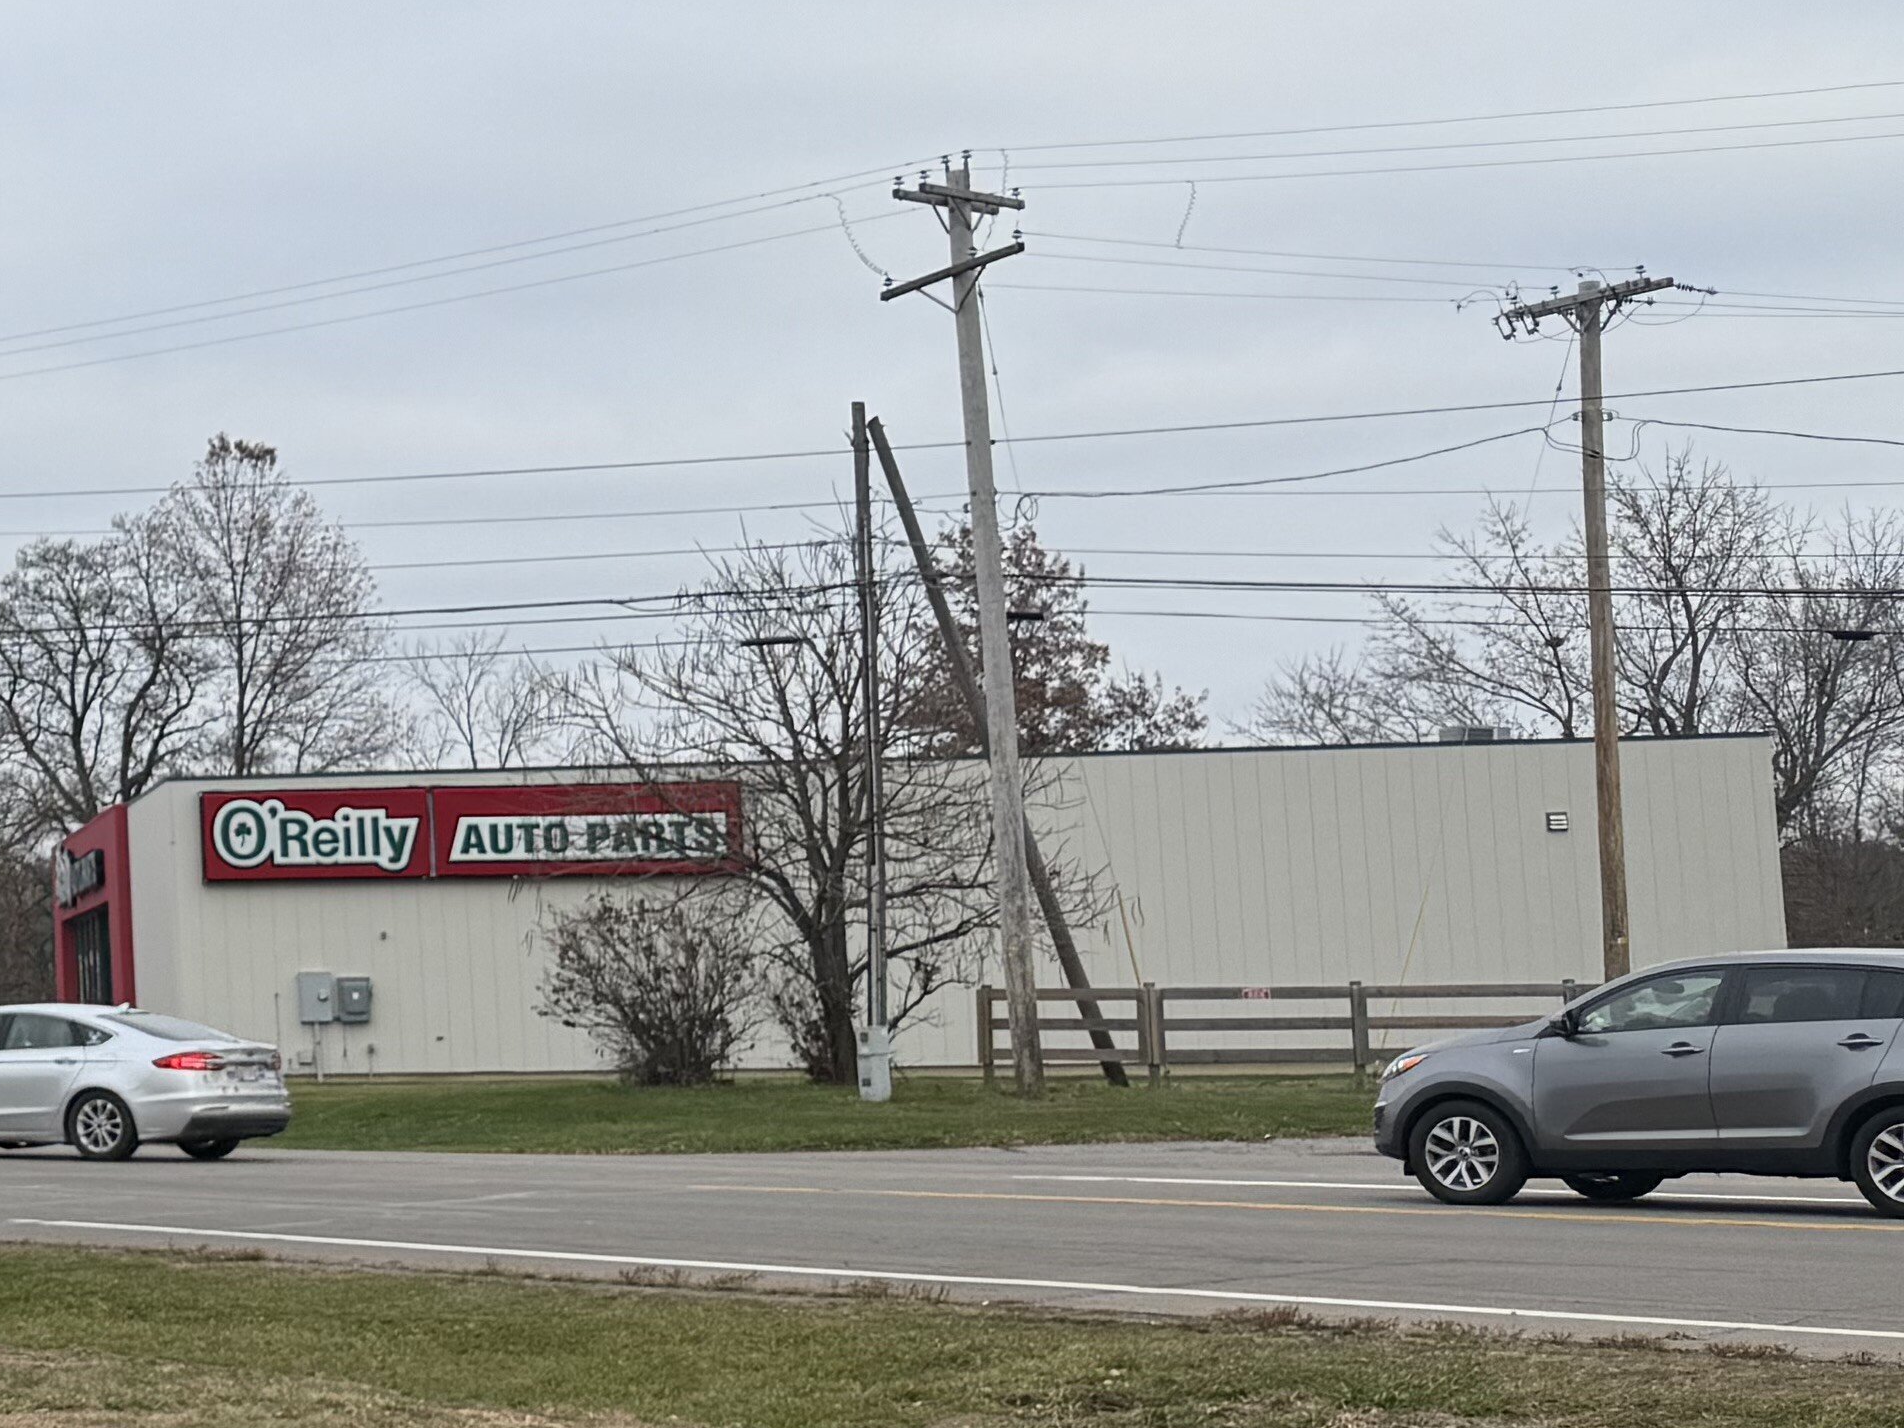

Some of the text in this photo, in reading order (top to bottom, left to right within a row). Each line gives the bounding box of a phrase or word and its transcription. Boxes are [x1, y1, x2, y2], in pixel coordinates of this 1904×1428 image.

[219, 803, 726, 864] O'Reilly AUTO PARTS
